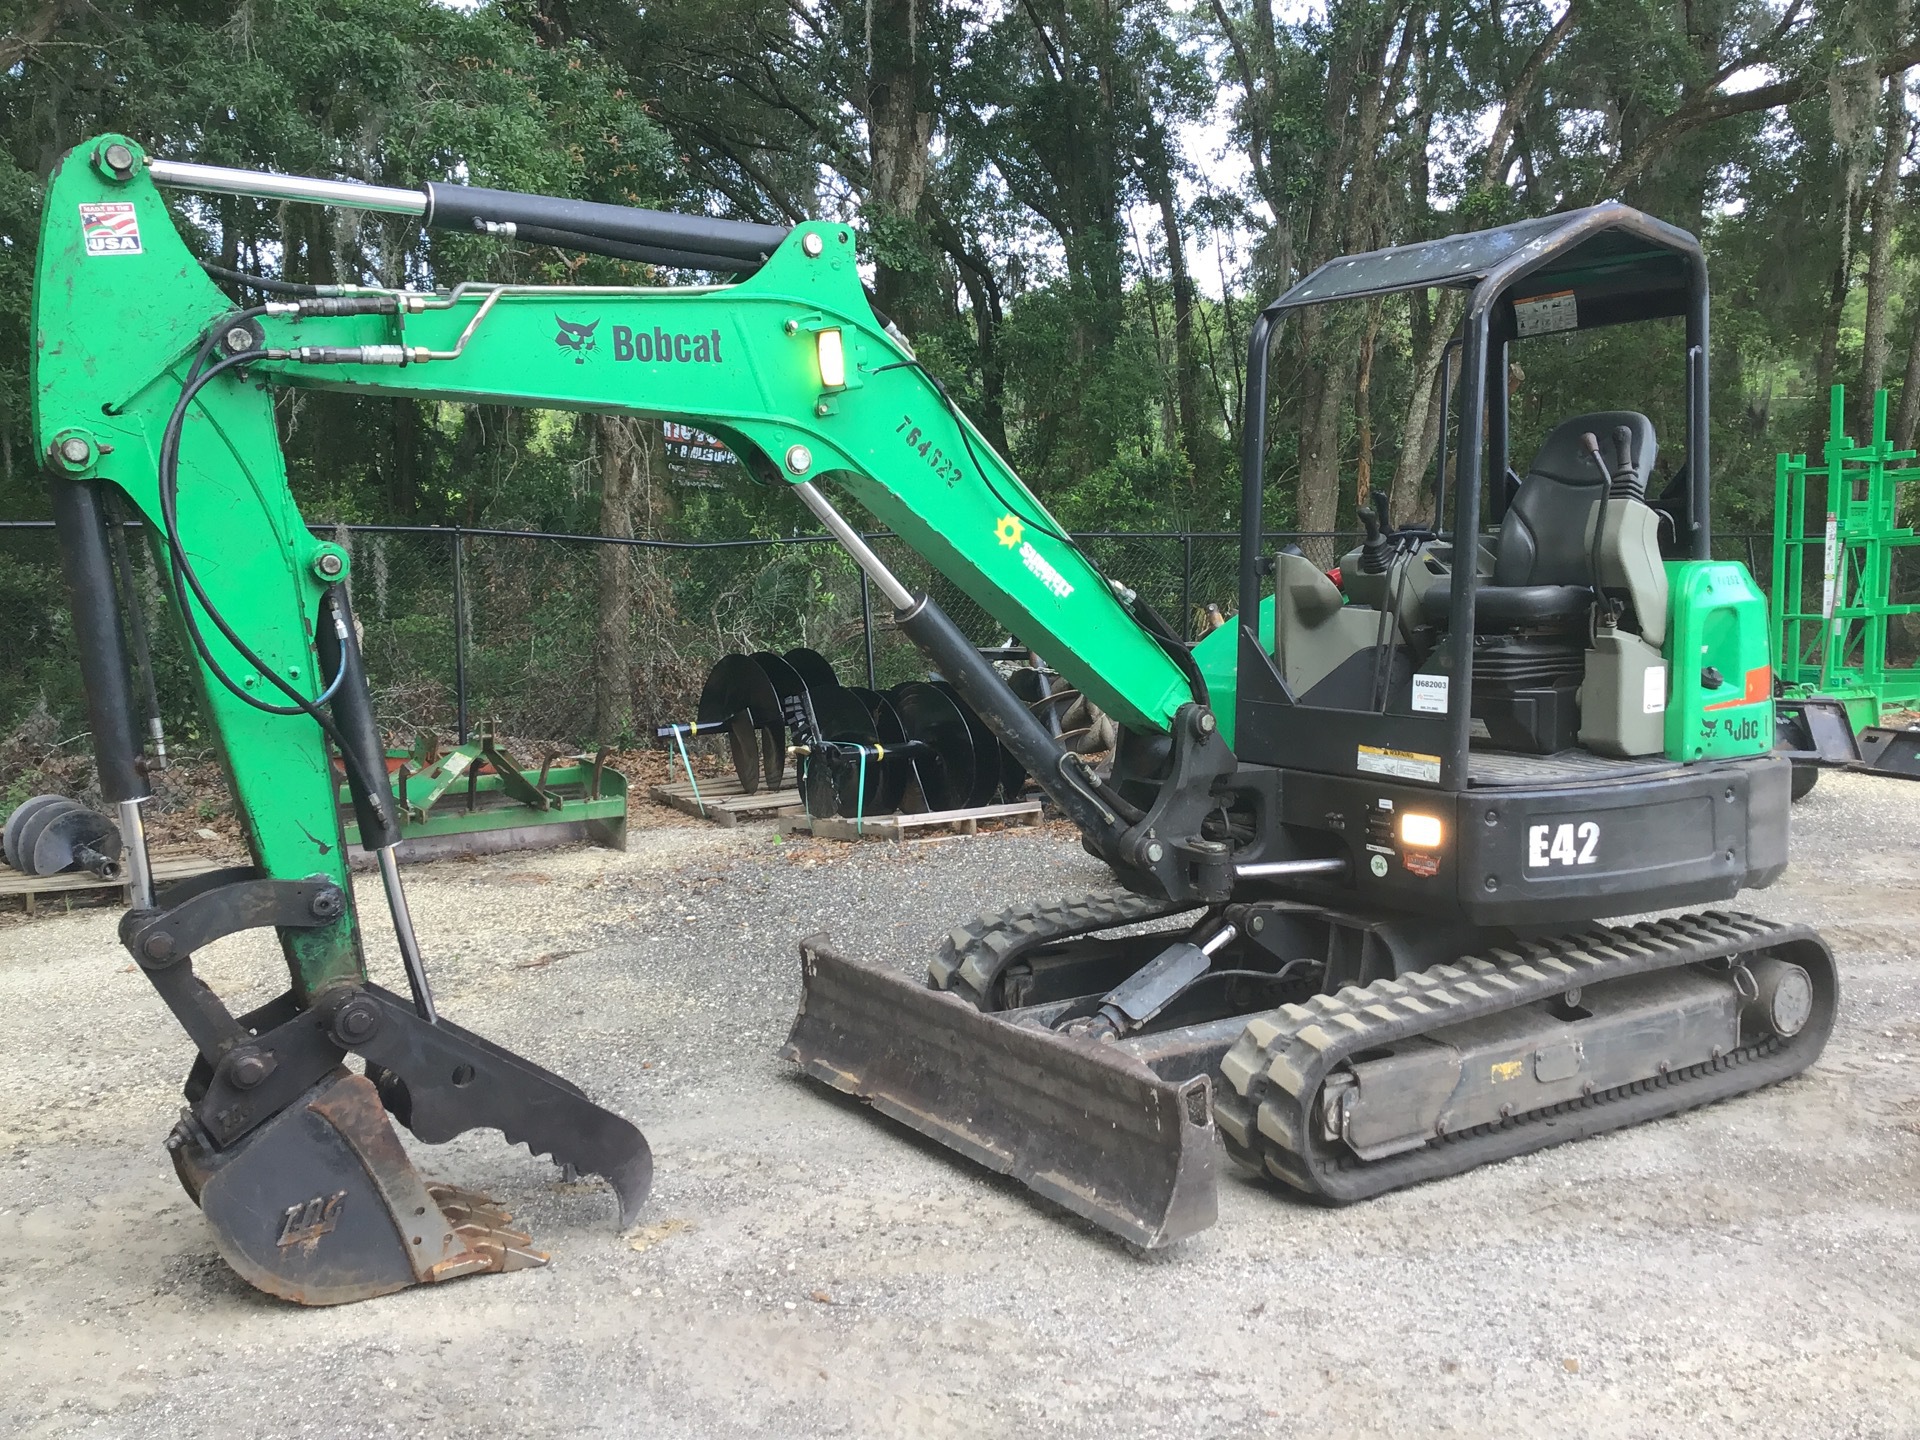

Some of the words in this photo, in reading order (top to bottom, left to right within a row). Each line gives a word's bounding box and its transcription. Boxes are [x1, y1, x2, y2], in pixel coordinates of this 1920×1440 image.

[89, 237, 138, 250] USA
[612, 325, 723, 363] Bobcat
[1415, 680, 1447, 689] U682003
[1389, 750, 1414, 759] WARNING
[1529, 821, 1601, 867] E42
